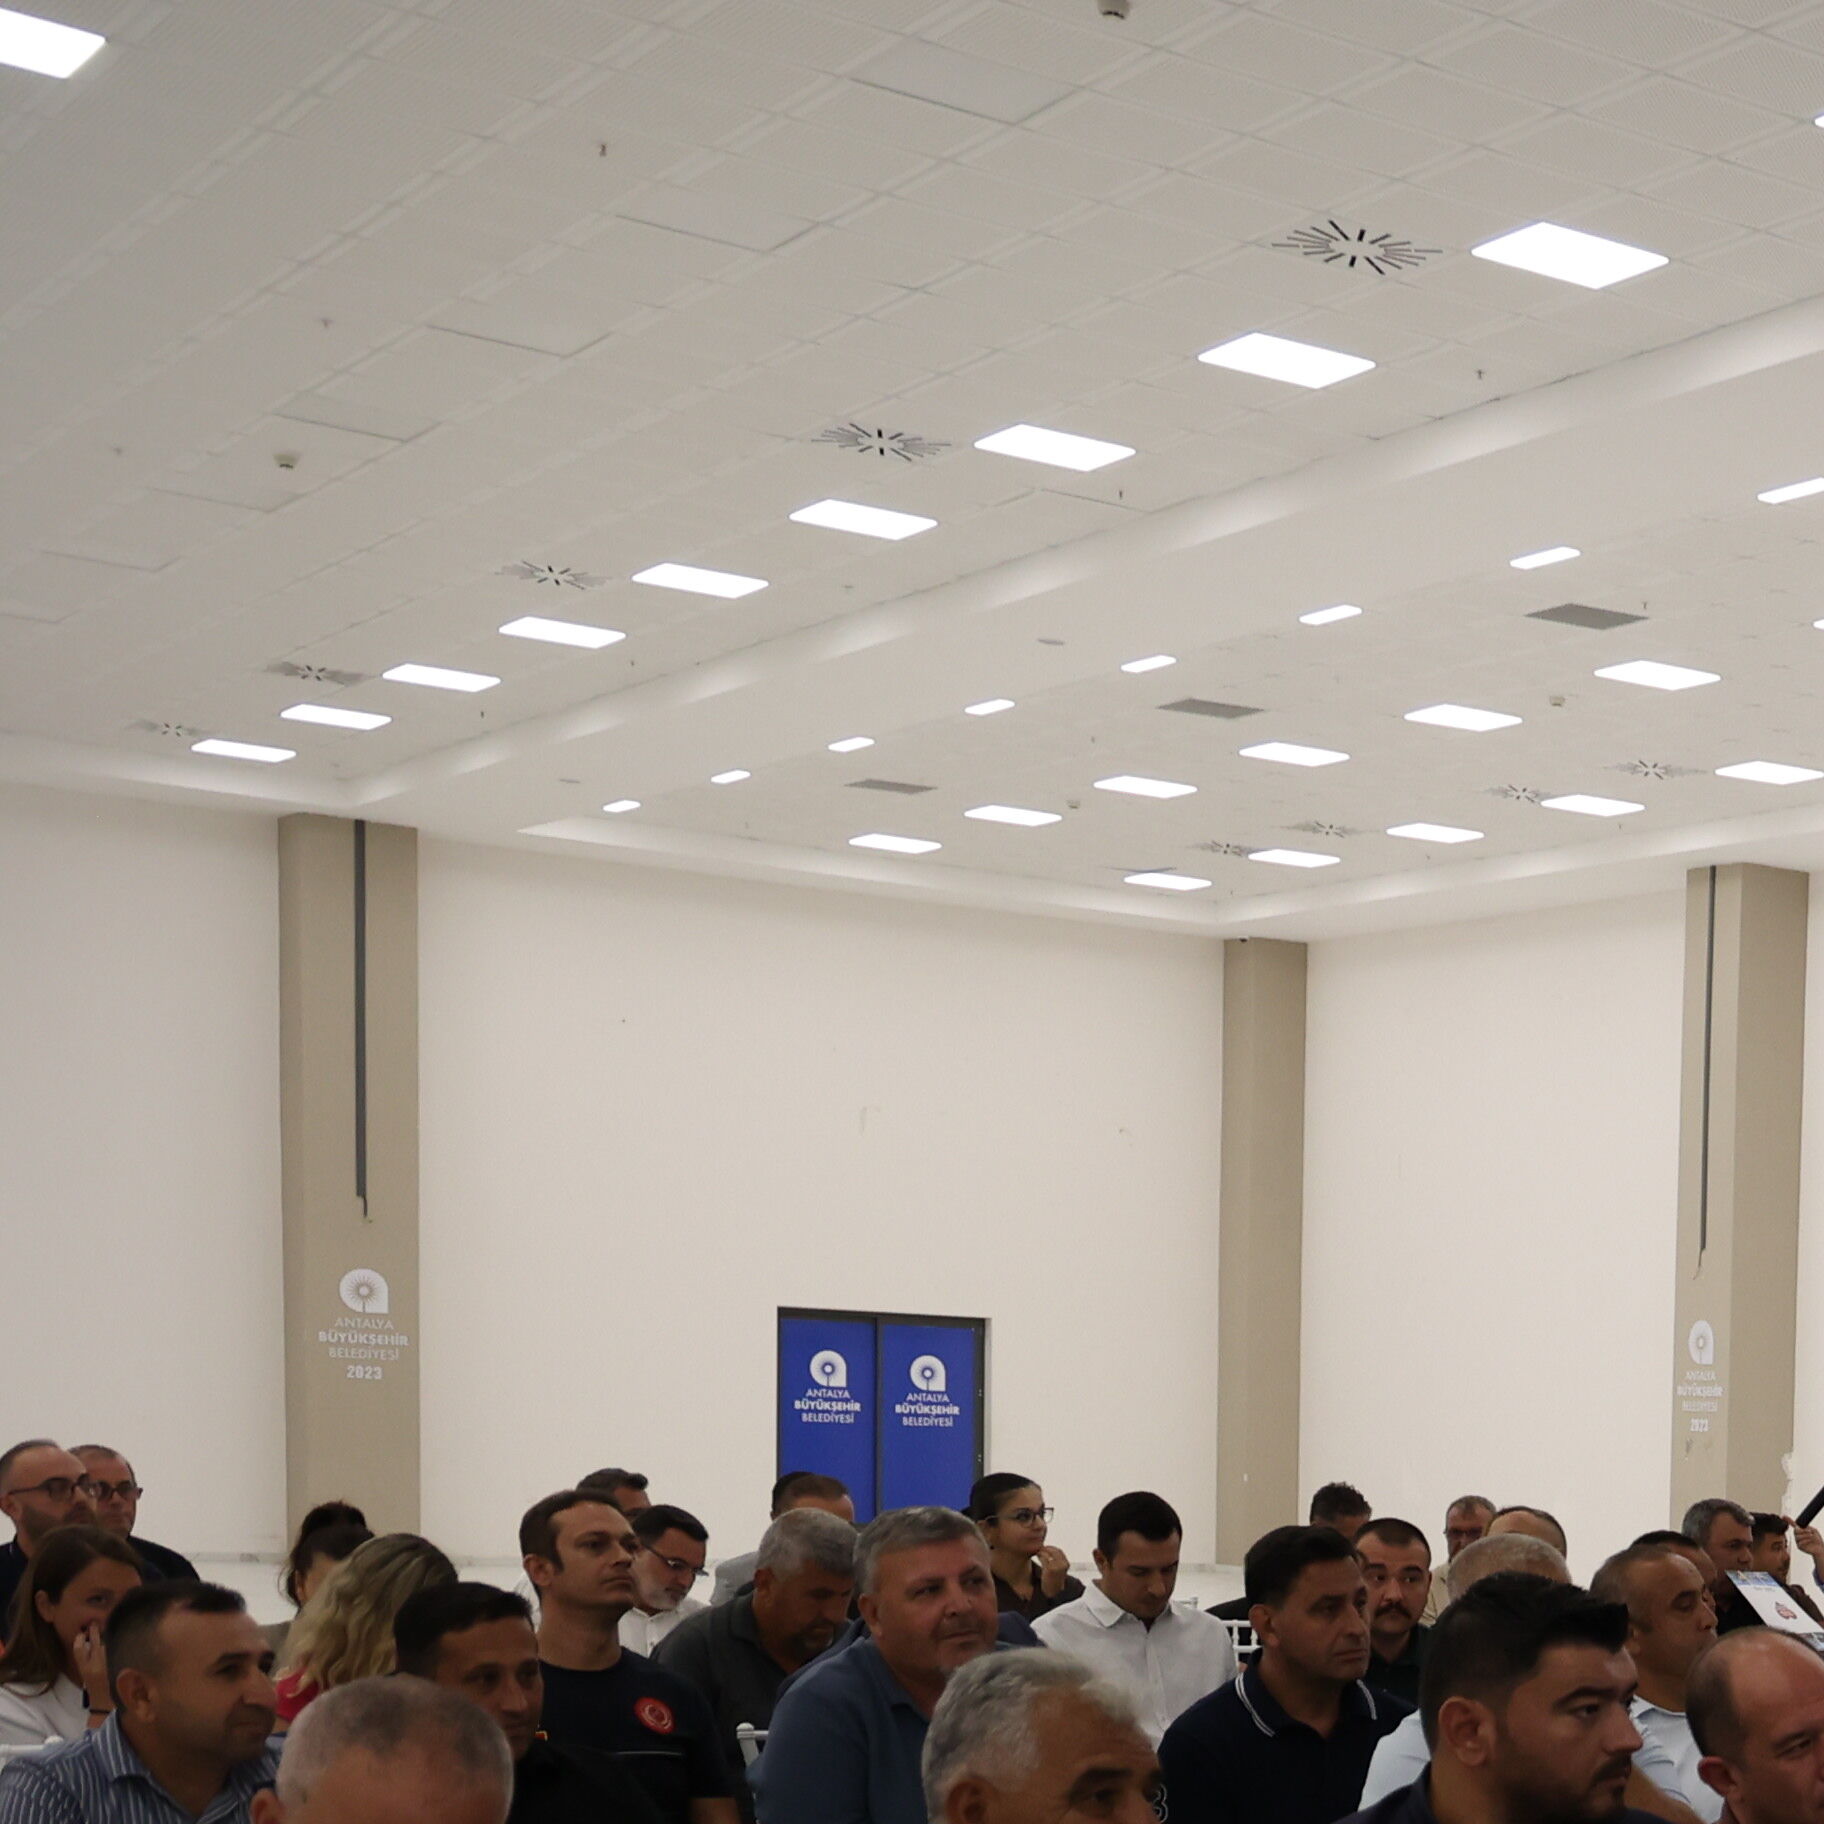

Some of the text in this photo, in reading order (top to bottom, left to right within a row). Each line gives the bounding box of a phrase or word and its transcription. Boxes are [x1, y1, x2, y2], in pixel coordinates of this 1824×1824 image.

[335, 1317, 394, 1330] ANTALYA
[347, 1365, 382, 1379] 2023
[806, 1388, 850, 1398] ANTALYA
[906, 1393, 950, 1403] ANTALYA
[794, 1399, 861, 1413] BÜYÜKŞEHİR
[895, 1403, 960, 1417] BÜYÜKŞEHİR
[802, 1412, 854, 1424] BELEDİYESİ
[902, 1416, 953, 1427] BELEDİYESİ
